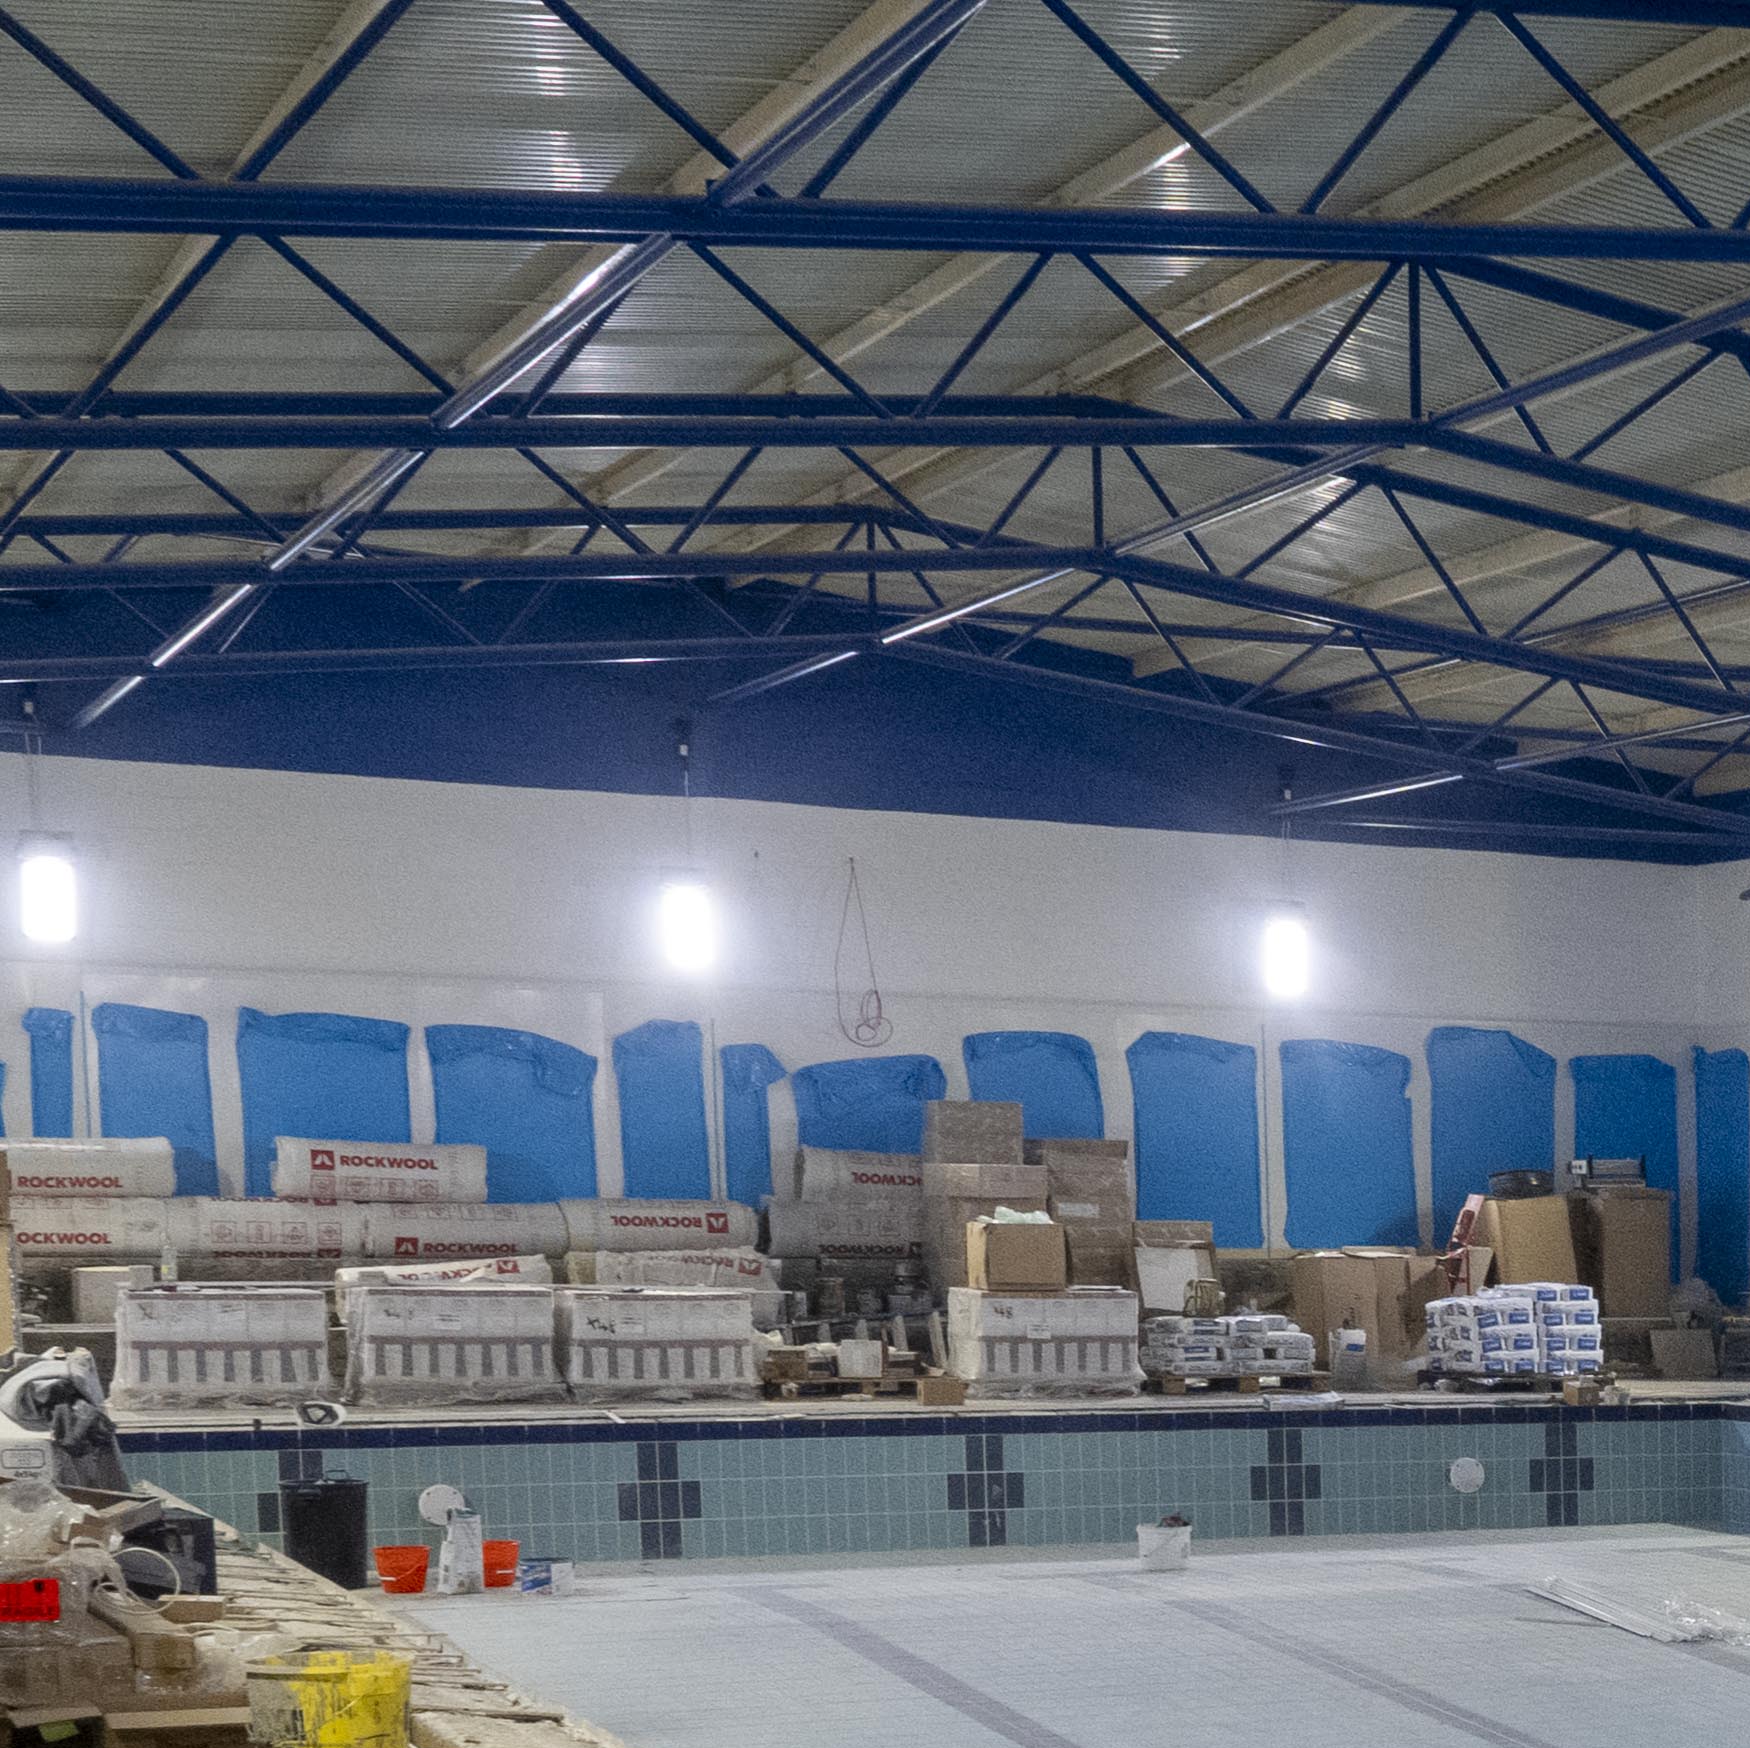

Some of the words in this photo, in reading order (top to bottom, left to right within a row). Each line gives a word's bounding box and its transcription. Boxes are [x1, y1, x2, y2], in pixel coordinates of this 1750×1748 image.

[340, 1155, 439, 1170] ROCKWOOL
[17, 1176, 123, 1188] ROCKWOOL
[851, 1172, 922, 1186] CKWOOL
[611, 1215, 704, 1228] ROCKWOOL
[16, 1232, 112, 1245] OCKWOOL
[423, 1242, 519, 1254] ROCKWOOL
